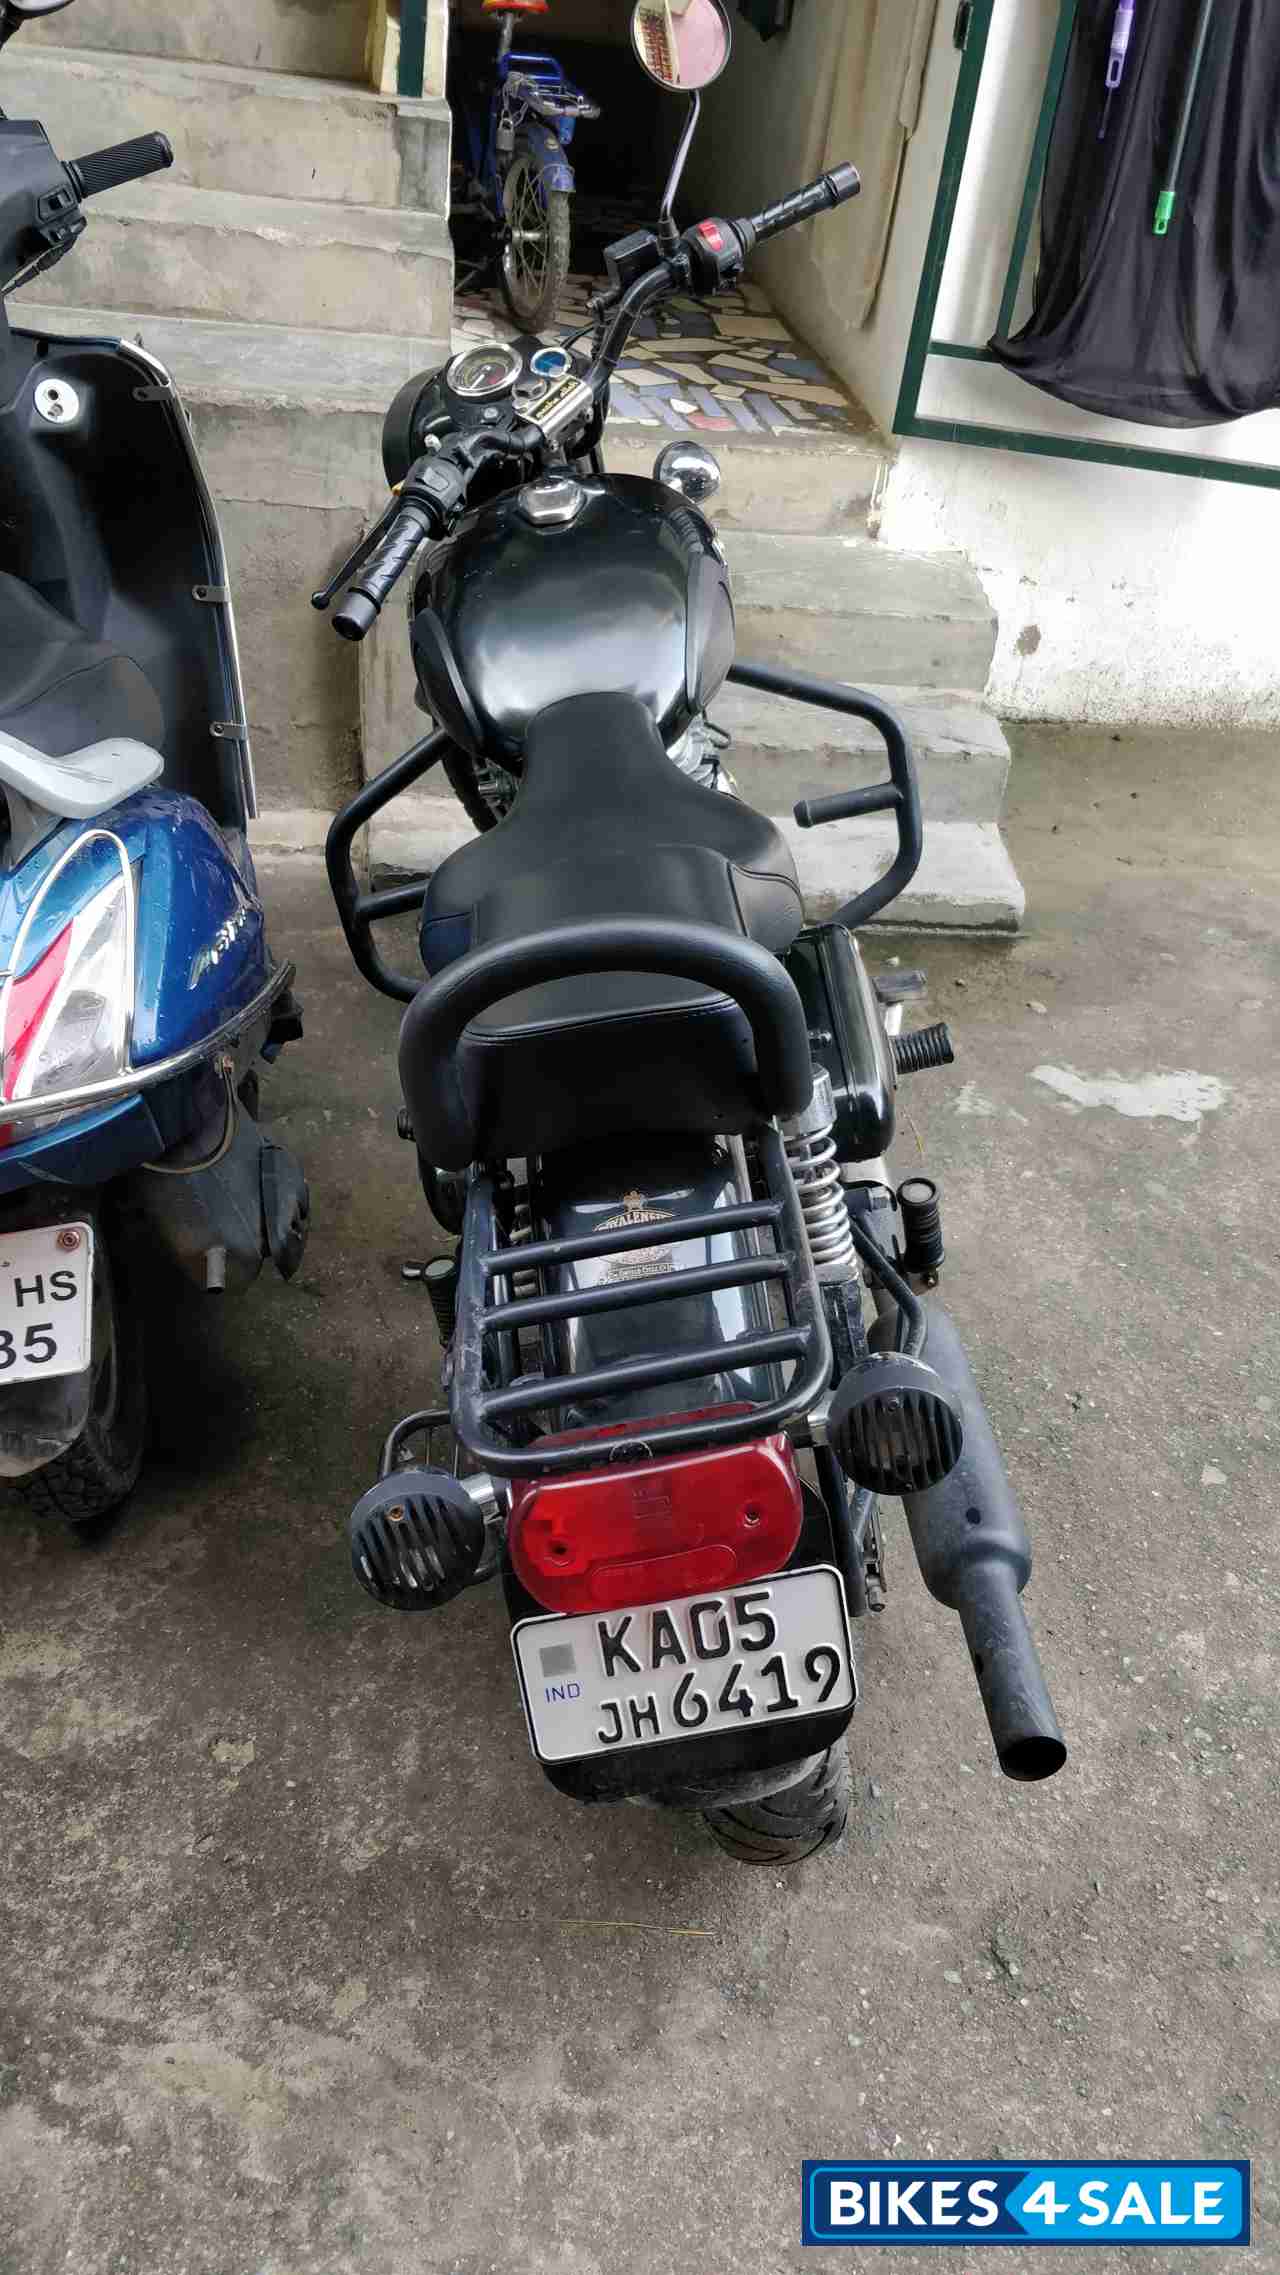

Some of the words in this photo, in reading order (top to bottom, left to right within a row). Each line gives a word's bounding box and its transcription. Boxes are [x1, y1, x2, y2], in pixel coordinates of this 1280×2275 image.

[14, 1270, 78, 1307] HS
[598, 1592, 777, 1677] KA05
[545, 1682, 581, 1702] IND
